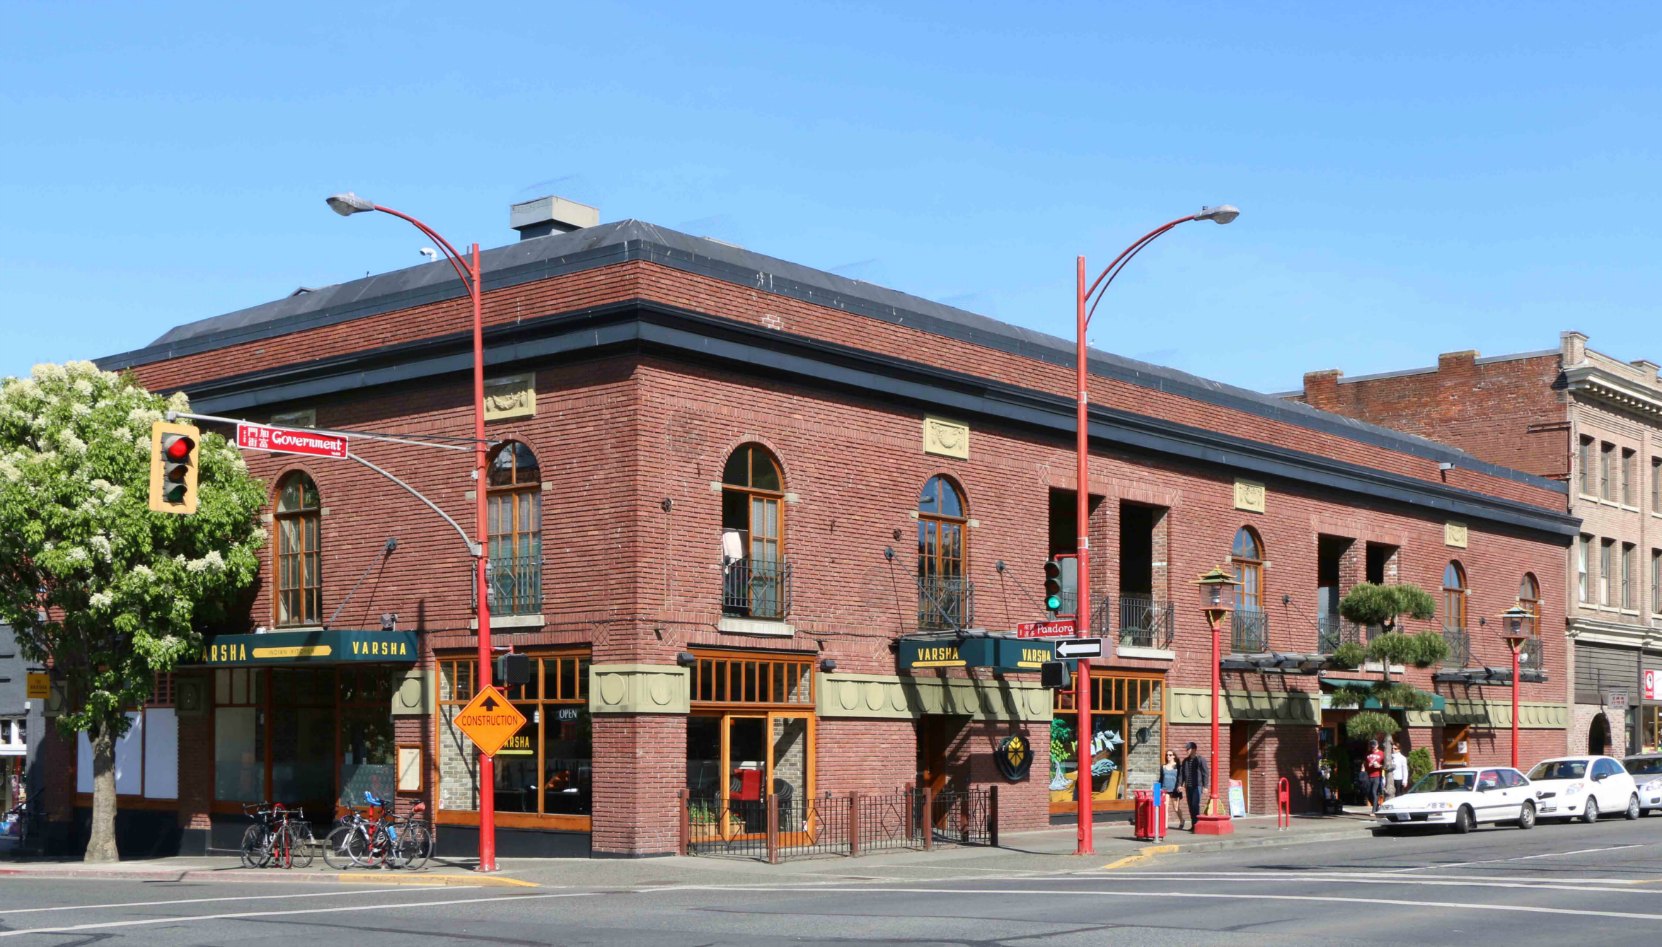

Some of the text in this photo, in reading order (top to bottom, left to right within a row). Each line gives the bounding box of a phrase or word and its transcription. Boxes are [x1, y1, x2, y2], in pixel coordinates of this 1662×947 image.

[271, 431, 343, 451] Government
[1037, 624, 1074, 635] Pandora
[193, 643, 247, 661] ARSHA
[352, 641, 407, 655] VARSHA
[917, 647, 959, 661] VARSHA
[1022, 648, 1052, 662] VARSHA
[461, 715, 518, 726] CONSTRUCTION
[559, 708, 577, 719] OPEN
[503, 735, 530, 748] ARSHA
